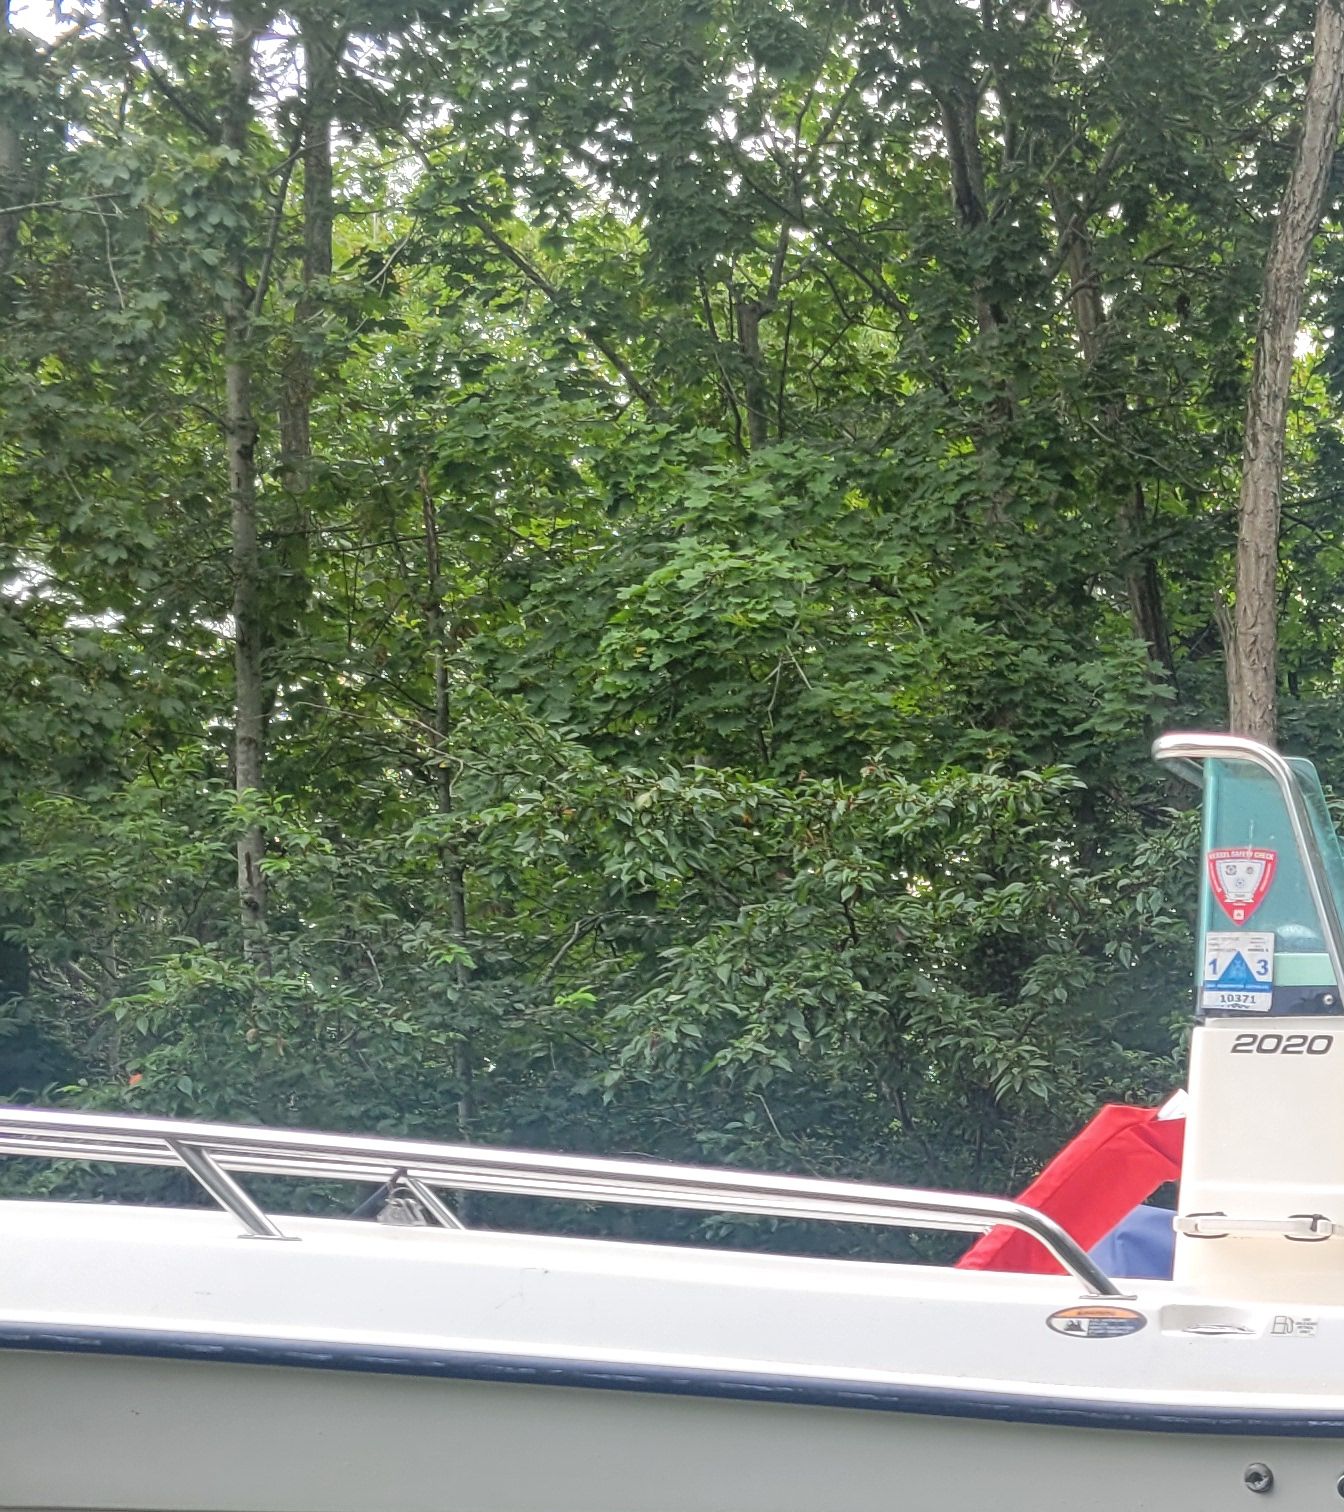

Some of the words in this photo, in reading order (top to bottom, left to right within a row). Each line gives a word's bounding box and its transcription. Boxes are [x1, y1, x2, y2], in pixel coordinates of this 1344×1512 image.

[1208, 957, 1218, 975] 1
[1256, 959, 1269, 976] 3
[1220, 993, 1256, 1005] 10371
[1230, 1033, 1334, 1055] 2020
